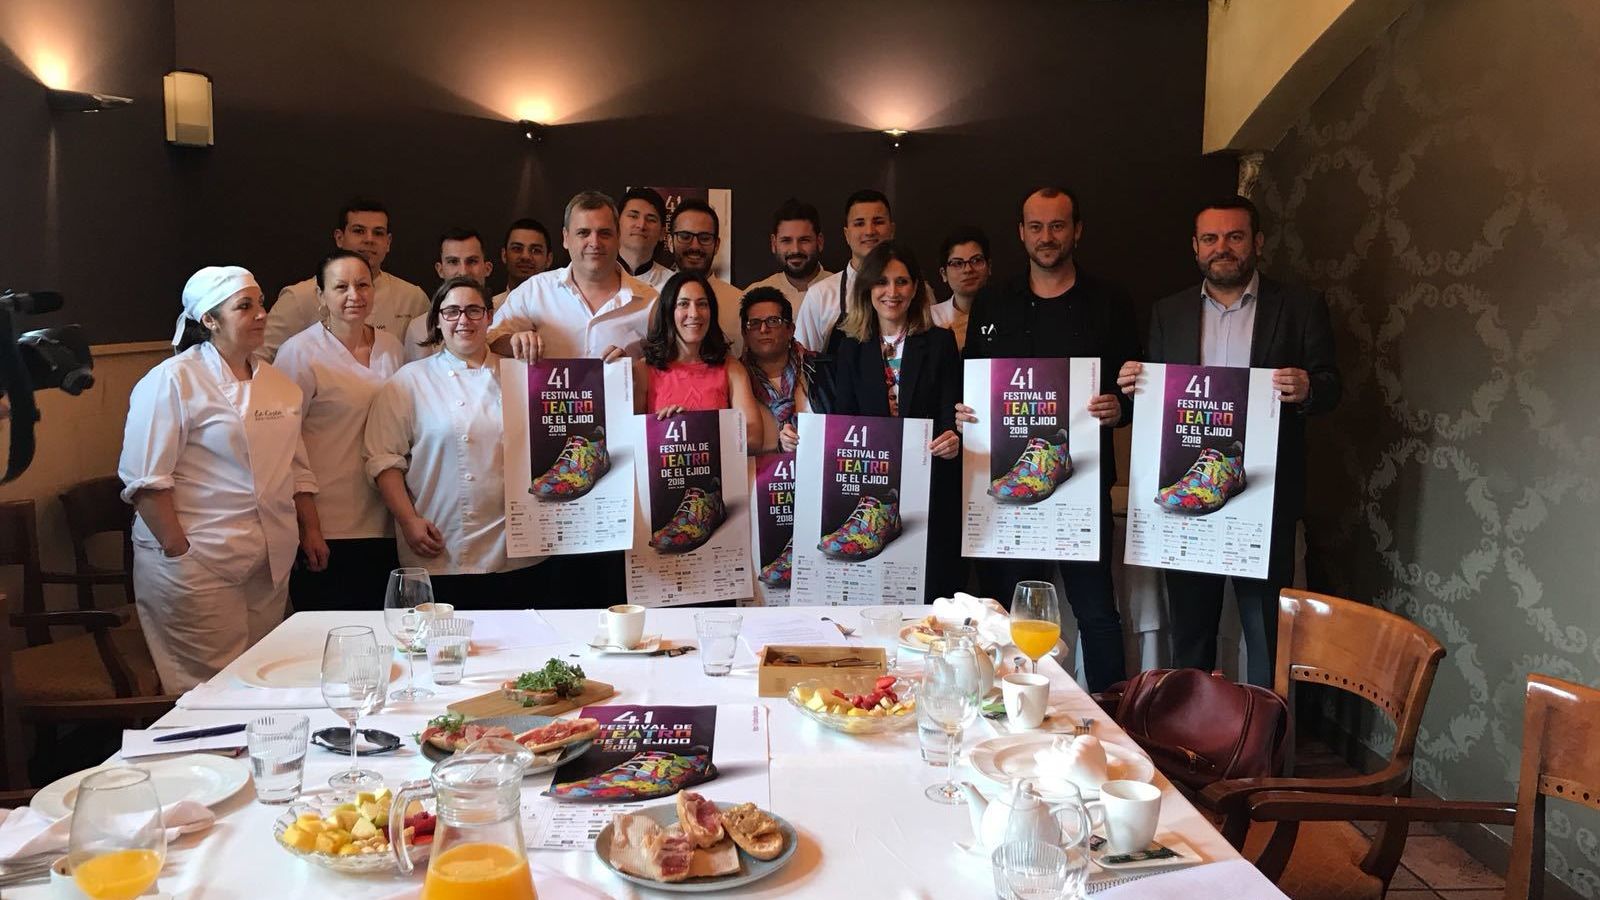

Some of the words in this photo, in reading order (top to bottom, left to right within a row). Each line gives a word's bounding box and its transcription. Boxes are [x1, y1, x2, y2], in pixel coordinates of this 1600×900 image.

[548, 368, 569, 389] 41
[1010, 368, 1033, 389] 41
[1185, 375, 1210, 398] 41
[541, 391, 579, 400] FESTIVAL
[582, 391, 592, 399] DE
[1004, 392, 1042, 400] FESTIVAL
[1046, 392, 1056, 400] DE
[542, 401, 593, 414] TEATRO
[1004, 402, 1056, 415] TEATRO
[1178, 399, 1219, 410] FESTIVAL
[1222, 402, 1234, 411] DE
[542, 415, 553, 424] DE
[556, 415, 566, 424] EL
[568, 415, 593, 424] EJIDO
[1004, 417, 1015, 426] DE
[1018, 417, 1028, 426] EL
[1030, 417, 1056, 426] EJIDO
[1177, 410, 1233, 426] TEATRO
[549, 425, 567, 433] 2018
[666, 421, 687, 442] 41
[1176, 425, 1188, 434] DE
[1191, 426, 1201, 435] EL
[1204, 427, 1233, 437] EJIDO
[844, 425, 868, 447] 41
[1182, 436, 1201, 444] 2018
[660, 444, 697, 453] FESTIVAL
[699, 443, 709, 451] DE
[837, 449, 875, 459] FESTIVAL
[879, 450, 889, 459] DE
[661, 452, 710, 468] TEATRO
[661, 468, 672, 478] DE
[675, 468, 684, 477] EL
[687, 466, 710, 476] EJIDO
[774, 460, 795, 480] 41
[837, 459, 889, 474] TEATRO
[668, 478, 685, 486] 2018
[836, 474, 848, 483] DE
[850, 474, 860, 484] EL
[862, 474, 889, 485] EJIDO
[769, 482, 795, 491] FESTIV
[842, 484, 860, 492] 2018
[770, 492, 794, 505] TEA
[770, 506, 781, 515] DE
[783, 506, 792, 515] EL
[776, 515, 793, 523] 2018
[613, 711, 654, 724] 41
[600, 730, 692, 739] TEATRO
